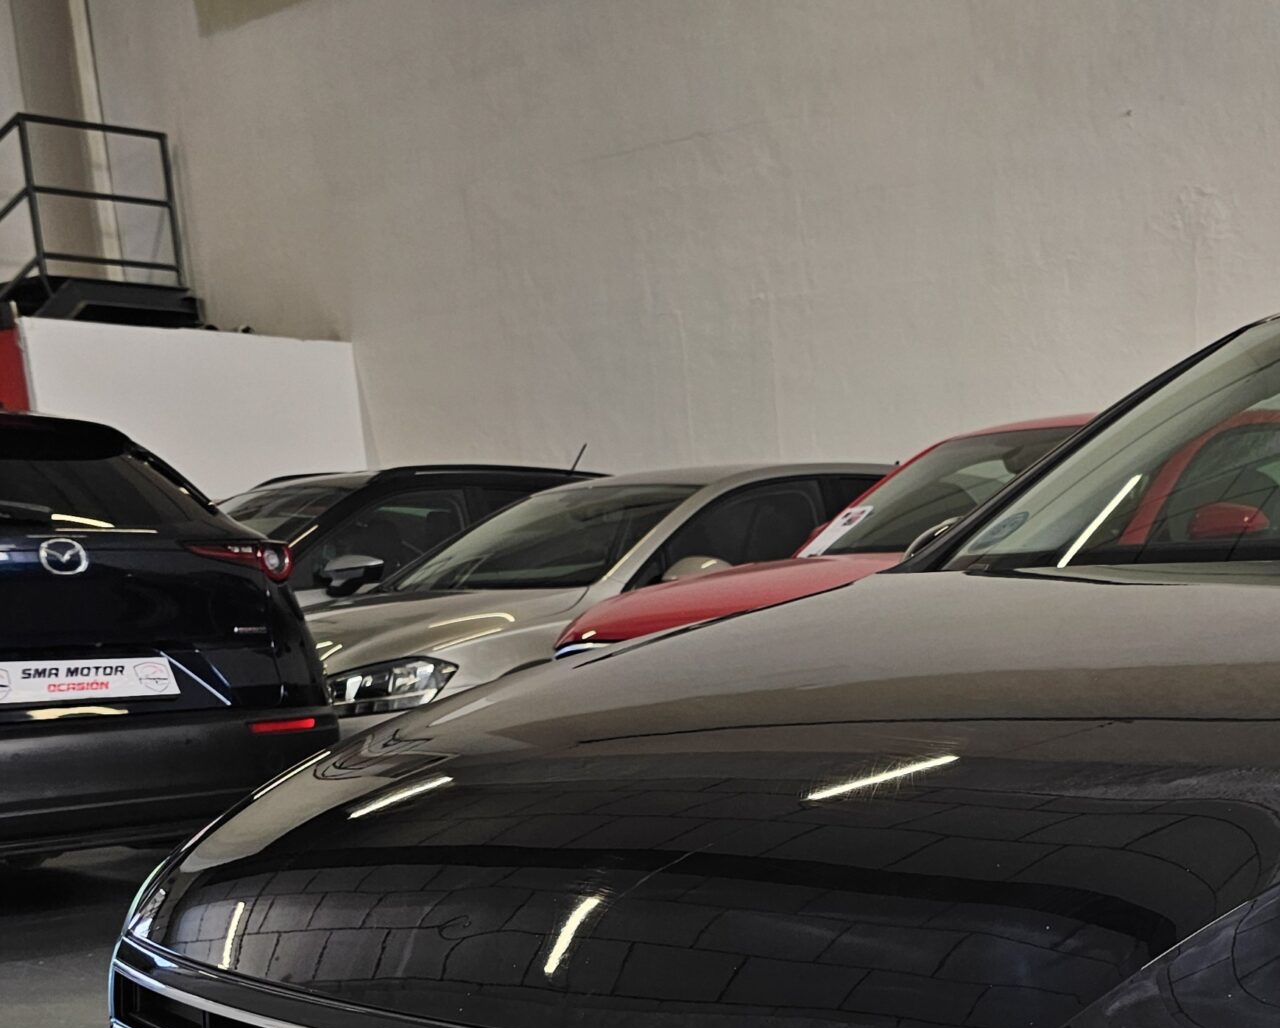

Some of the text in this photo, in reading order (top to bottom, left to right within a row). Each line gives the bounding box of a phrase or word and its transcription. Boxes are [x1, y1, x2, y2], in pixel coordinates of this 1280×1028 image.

[21, 665, 125, 680] SMA MOTOR
[47, 679, 110, 693] OCASIÓN
